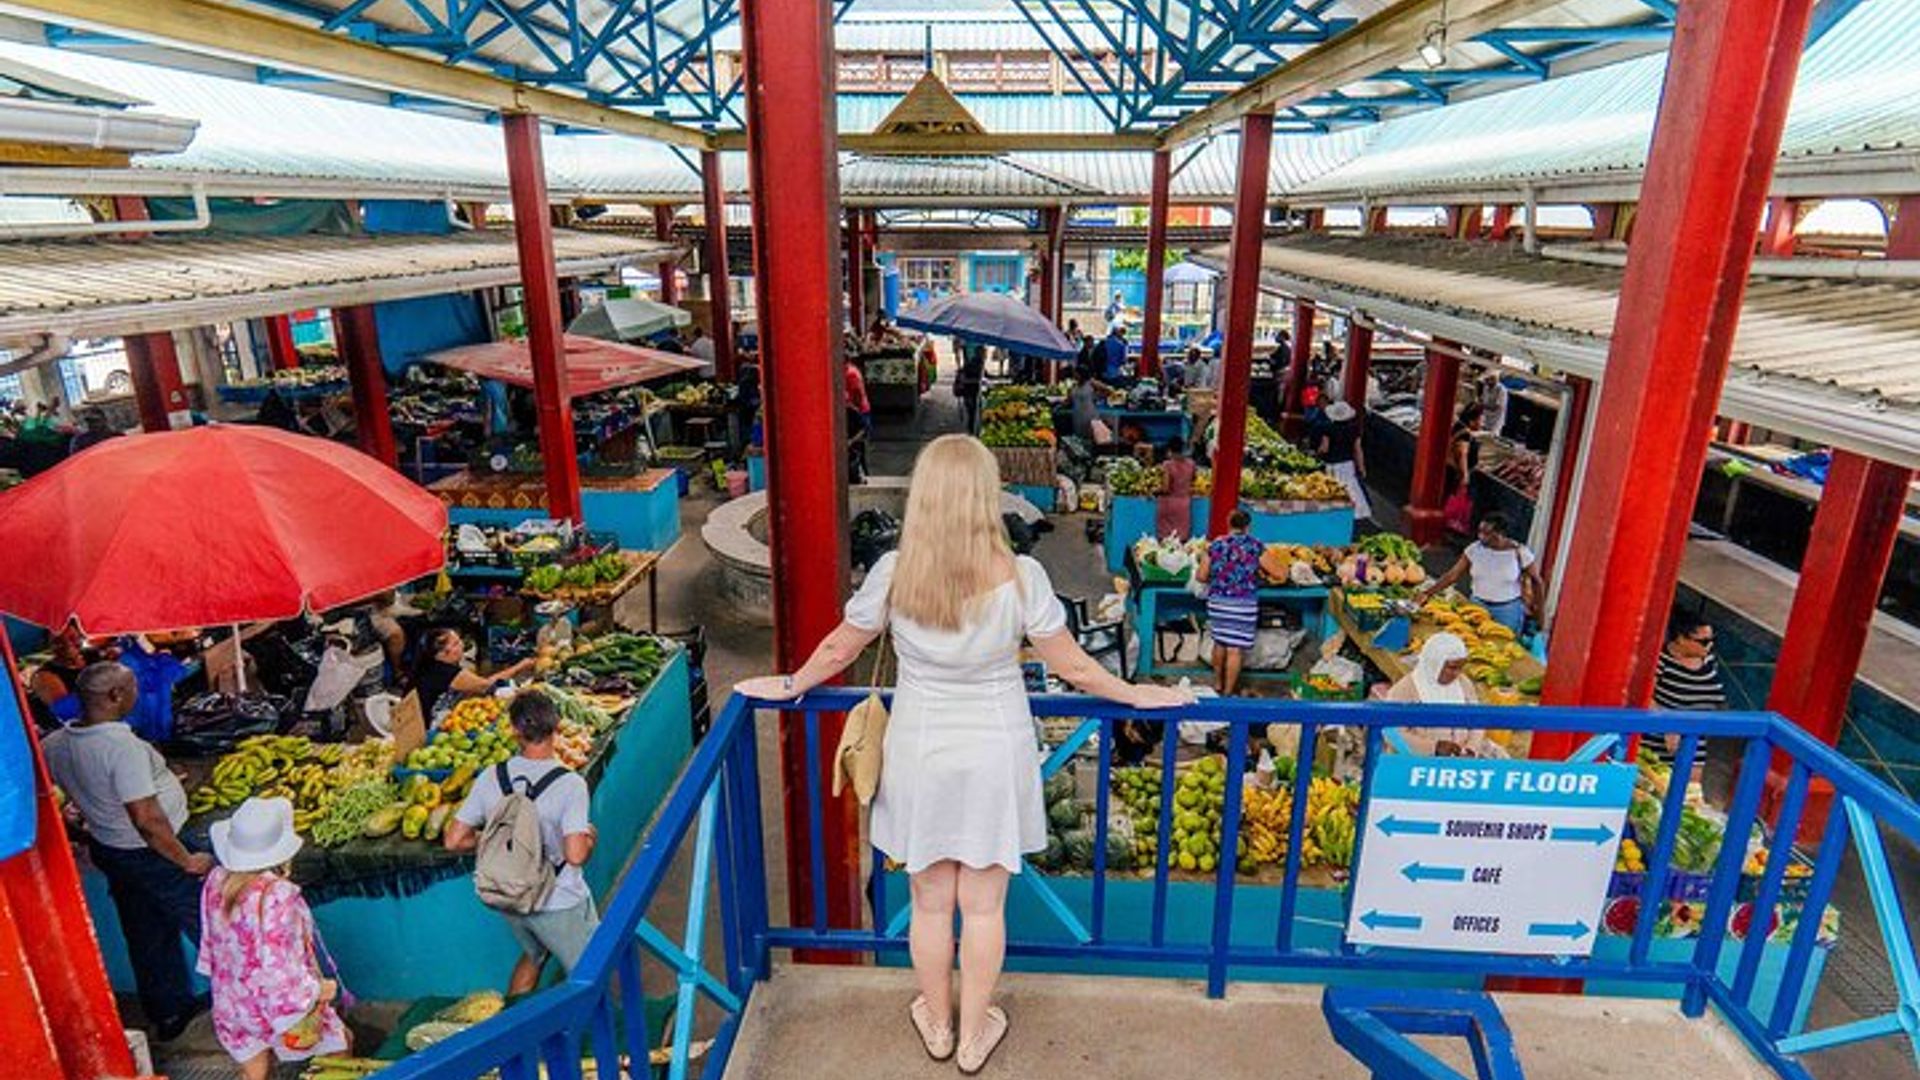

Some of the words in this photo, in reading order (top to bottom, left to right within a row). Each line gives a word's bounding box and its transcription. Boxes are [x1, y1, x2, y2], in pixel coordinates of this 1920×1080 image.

[1410, 767, 1494, 789] FIRST
[1504, 771, 1599, 794] FLOOR
[1445, 820, 1504, 839] SOUVENIR
[1507, 822, 1547, 840] SHOPS
[1453, 915, 1500, 933] OFFICES
